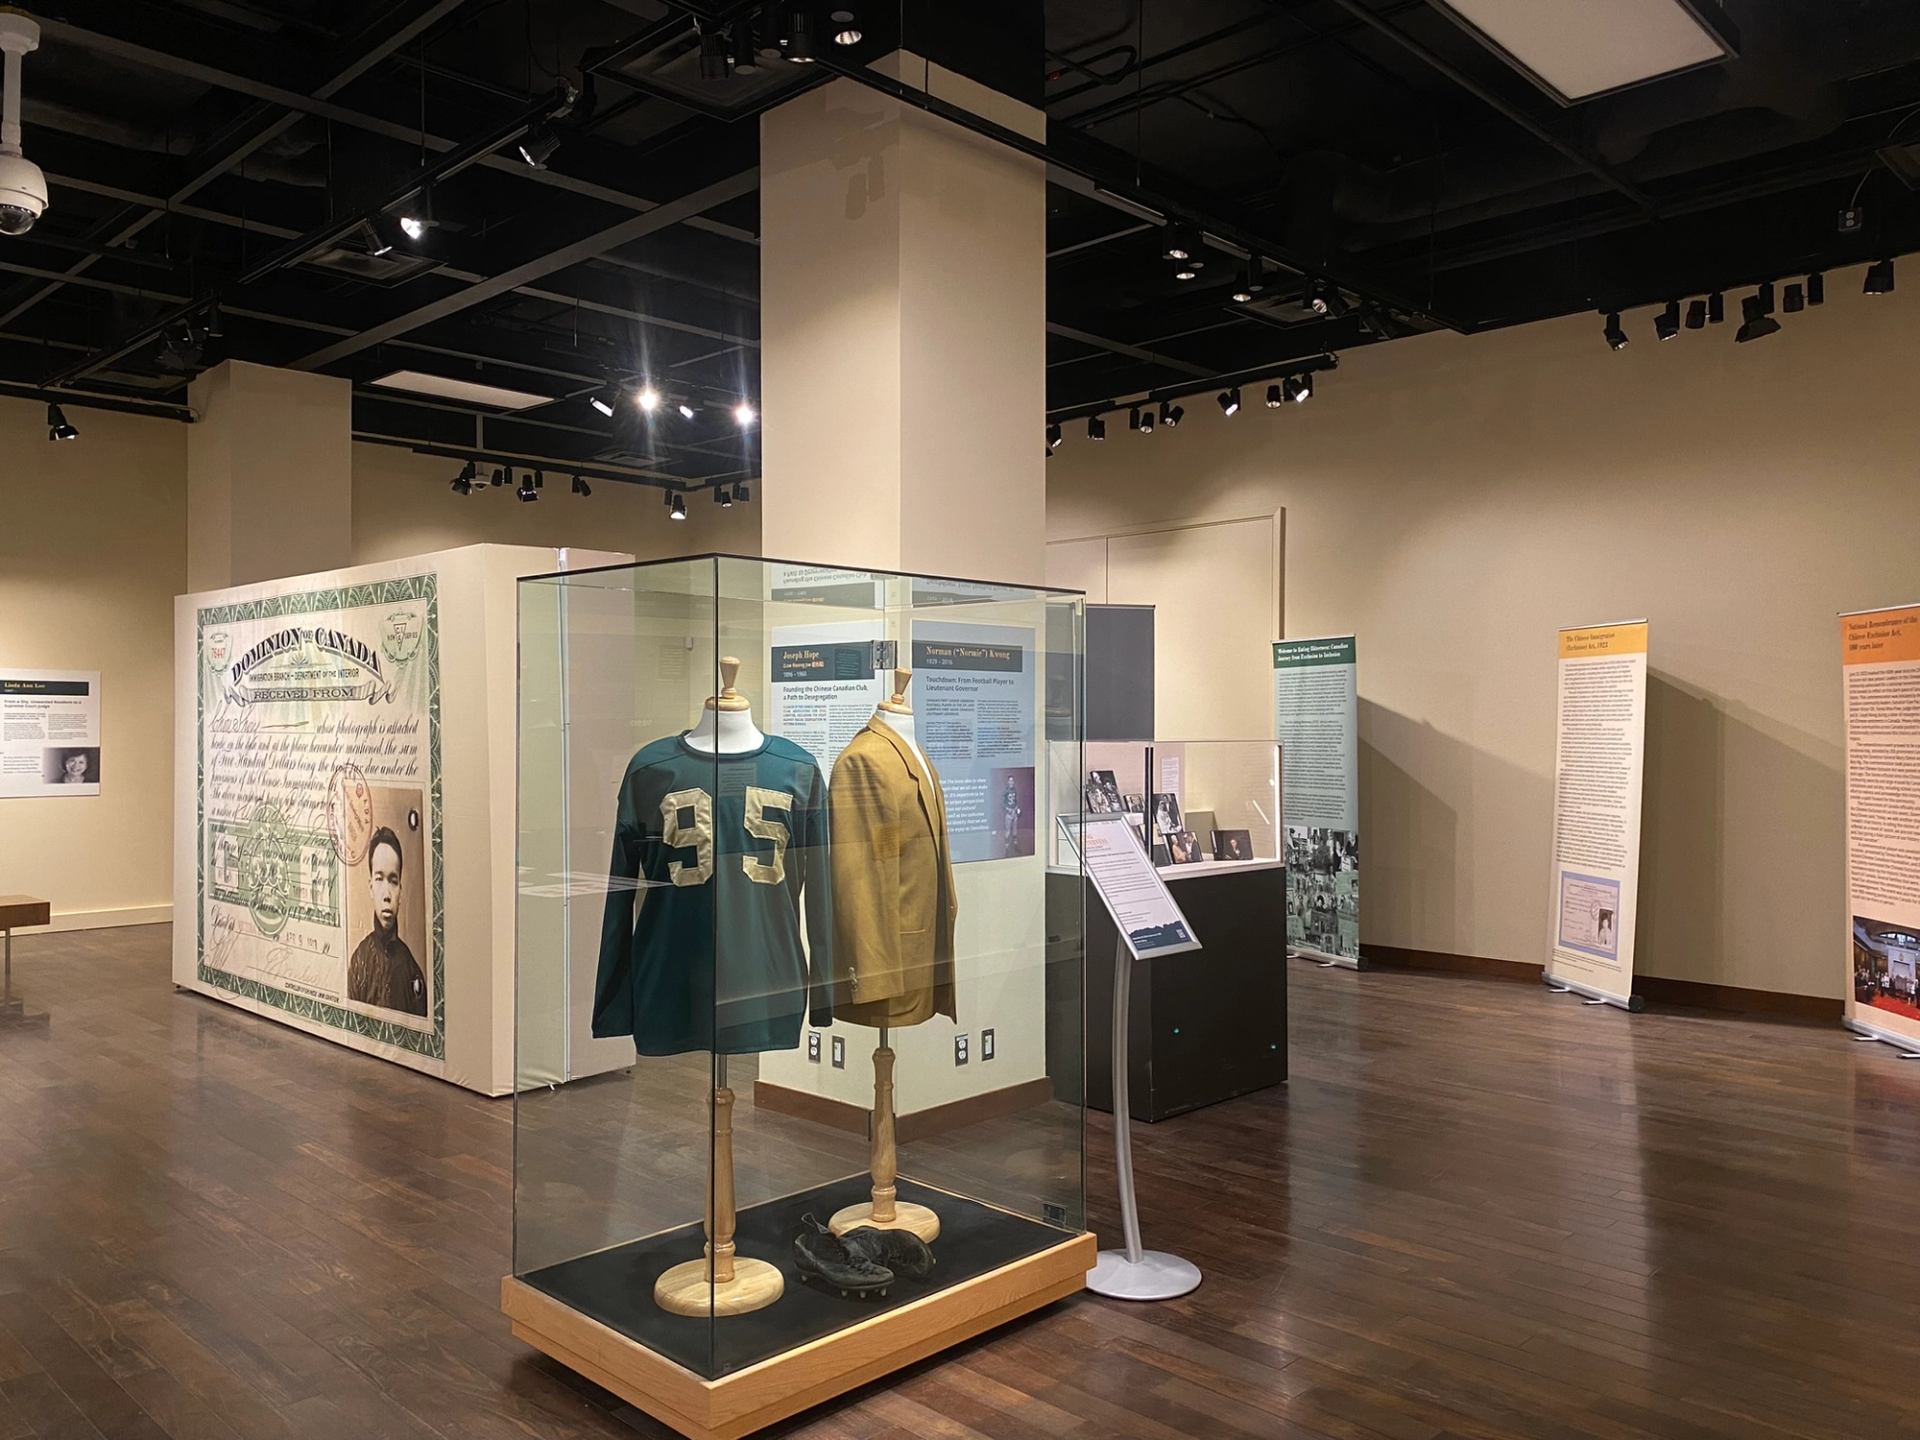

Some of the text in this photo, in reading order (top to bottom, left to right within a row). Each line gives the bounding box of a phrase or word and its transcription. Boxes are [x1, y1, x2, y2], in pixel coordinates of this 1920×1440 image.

[231, 626, 301, 682] DOMINION
[315, 627, 382, 674] CANADA
[783, 650, 820, 661] Joseph Hope
[926, 646, 952, 656] Norman
[989, 649, 1011, 660] Kwong
[295, 670, 321, 681] DEPARTMENT
[337, 668, 360, 679] INTERIOR
[926, 676, 957, 684] Touchdown:
[972, 677, 992, 685] Football
[992, 678, 1008, 686] Player
[254, 688, 354, 699] RECEIVED FROM
[804, 694, 838, 702] Desegregation
[336, 714, 380, 741] photograph
[387, 714, 419, 735] attached
[381, 758, 405, 776] under
[659, 786, 794, 887] 95
